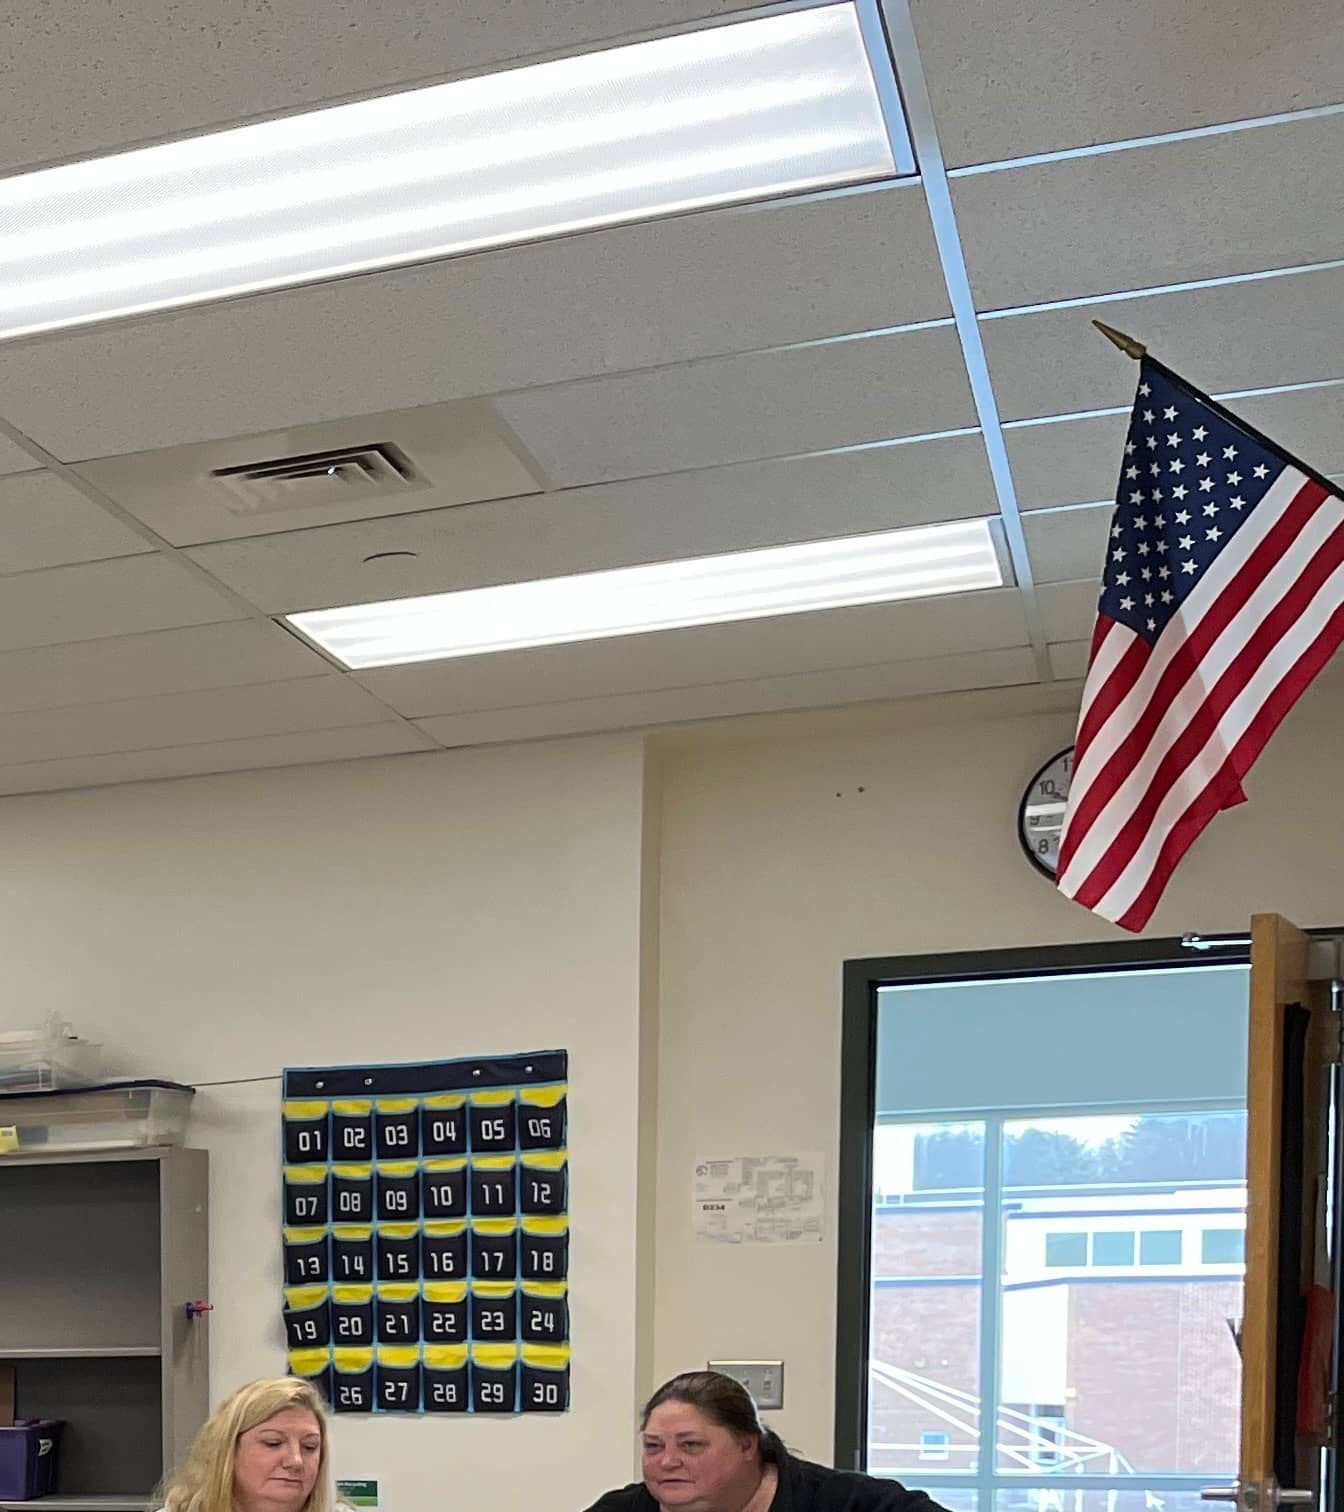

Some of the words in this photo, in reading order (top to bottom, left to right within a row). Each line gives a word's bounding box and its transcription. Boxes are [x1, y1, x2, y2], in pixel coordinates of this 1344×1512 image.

[1039, 838, 1049, 854] 8
[298, 1130, 321, 1152] 01
[343, 1127, 365, 1148] 02
[385, 1124, 409, 1146] 03
[433, 1121, 457, 1142] 04
[481, 1119, 505, 1140] 05
[528, 1118, 551, 1138] 06
[295, 1197, 318, 1216] 07
[340, 1191, 361, 1212] 08
[385, 1190, 407, 1211] 09
[430, 1185, 453, 1206] 10
[482, 1184, 503, 1205] 11
[531, 1181, 551, 1204] 12
[297, 1256, 320, 1276] 13
[341, 1255, 364, 1275] 14
[386, 1253, 409, 1273] 15
[430, 1252, 454, 1273] 16
[481, 1251, 504, 1272] 17
[531, 1250, 554, 1272] 18
[293, 1320, 317, 1341] 19
[339, 1316, 363, 1336] 20
[385, 1314, 409, 1334] 21
[432, 1312, 457, 1333] 22
[481, 1311, 505, 1331] 23
[531, 1310, 554, 1333] 24
[340, 1386, 363, 1405] 26
[384, 1381, 408, 1401] 27
[433, 1383, 457, 1403] 28
[480, 1382, 504, 1403] 29
[532, 1382, 558, 1404] 30
